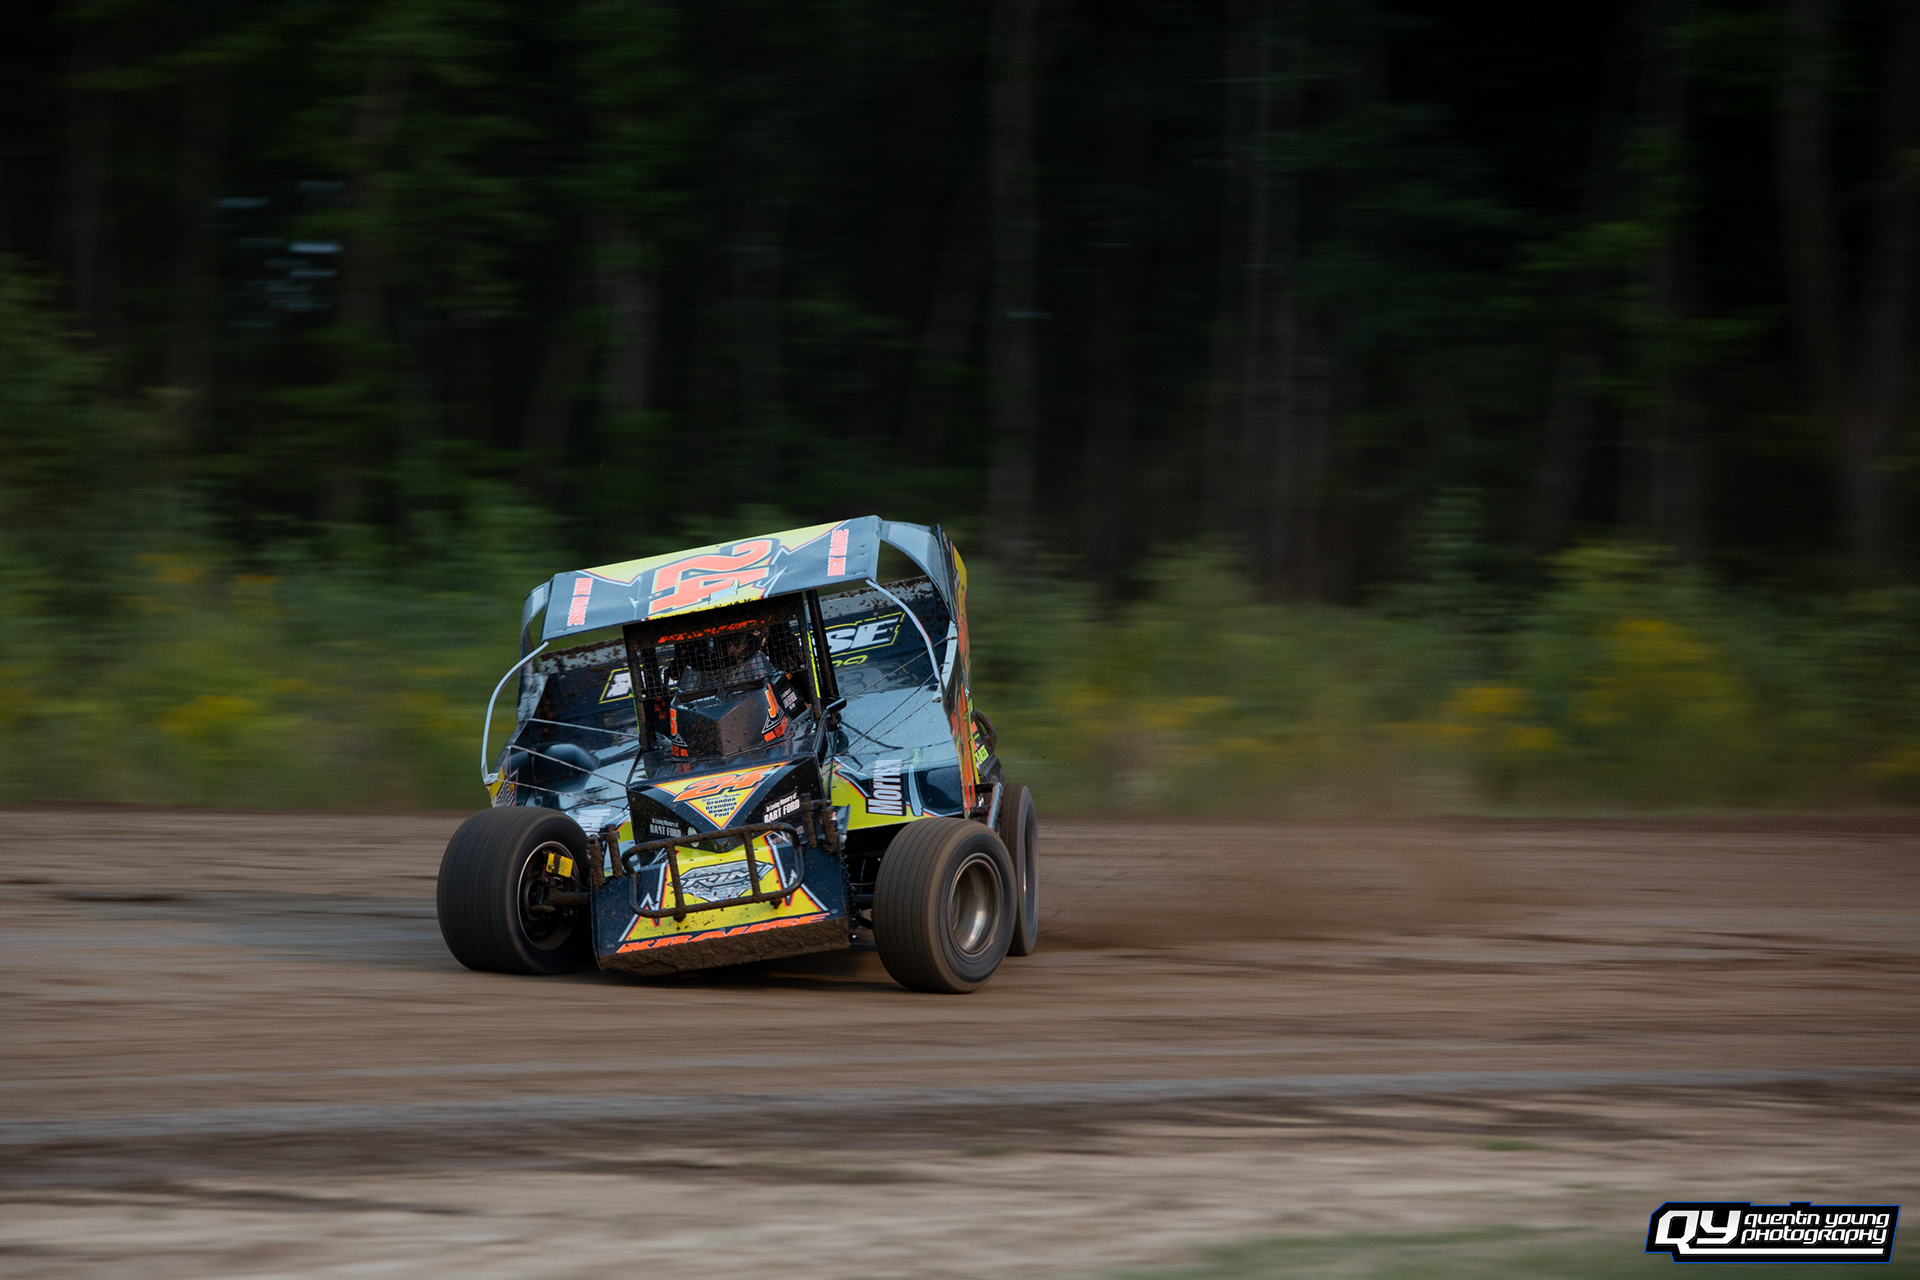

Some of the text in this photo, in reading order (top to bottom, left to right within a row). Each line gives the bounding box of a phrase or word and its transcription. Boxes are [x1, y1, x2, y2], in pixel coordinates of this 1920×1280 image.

[829, 528, 850, 556] KRAUSE
[650, 538, 774, 613] 24
[567, 577, 594, 627] NICK KRAUSE
[673, 764, 779, 803] 24
[705, 802, 738, 811] Grandma
[706, 797, 736, 806] Grandpa
[708, 806, 735, 814] Howard
[763, 798, 800, 824] BART FORD
[649, 823, 666, 836] BART
